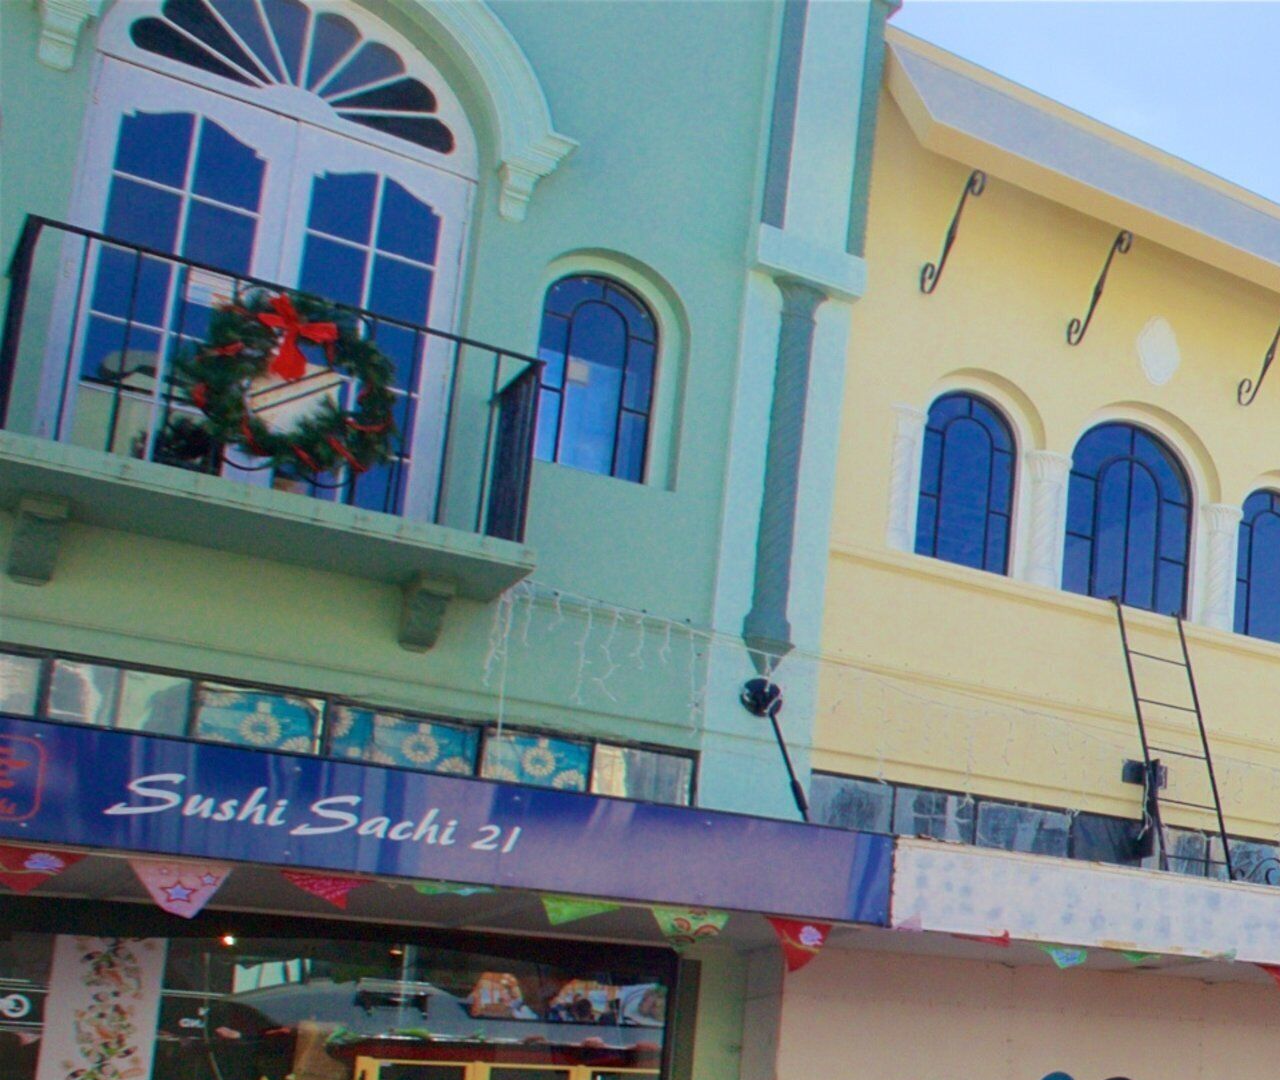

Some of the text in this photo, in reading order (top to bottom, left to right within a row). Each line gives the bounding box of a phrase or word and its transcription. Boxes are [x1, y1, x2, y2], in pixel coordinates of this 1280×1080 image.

[103, 773, 523, 853] Sushi Sachi 21
